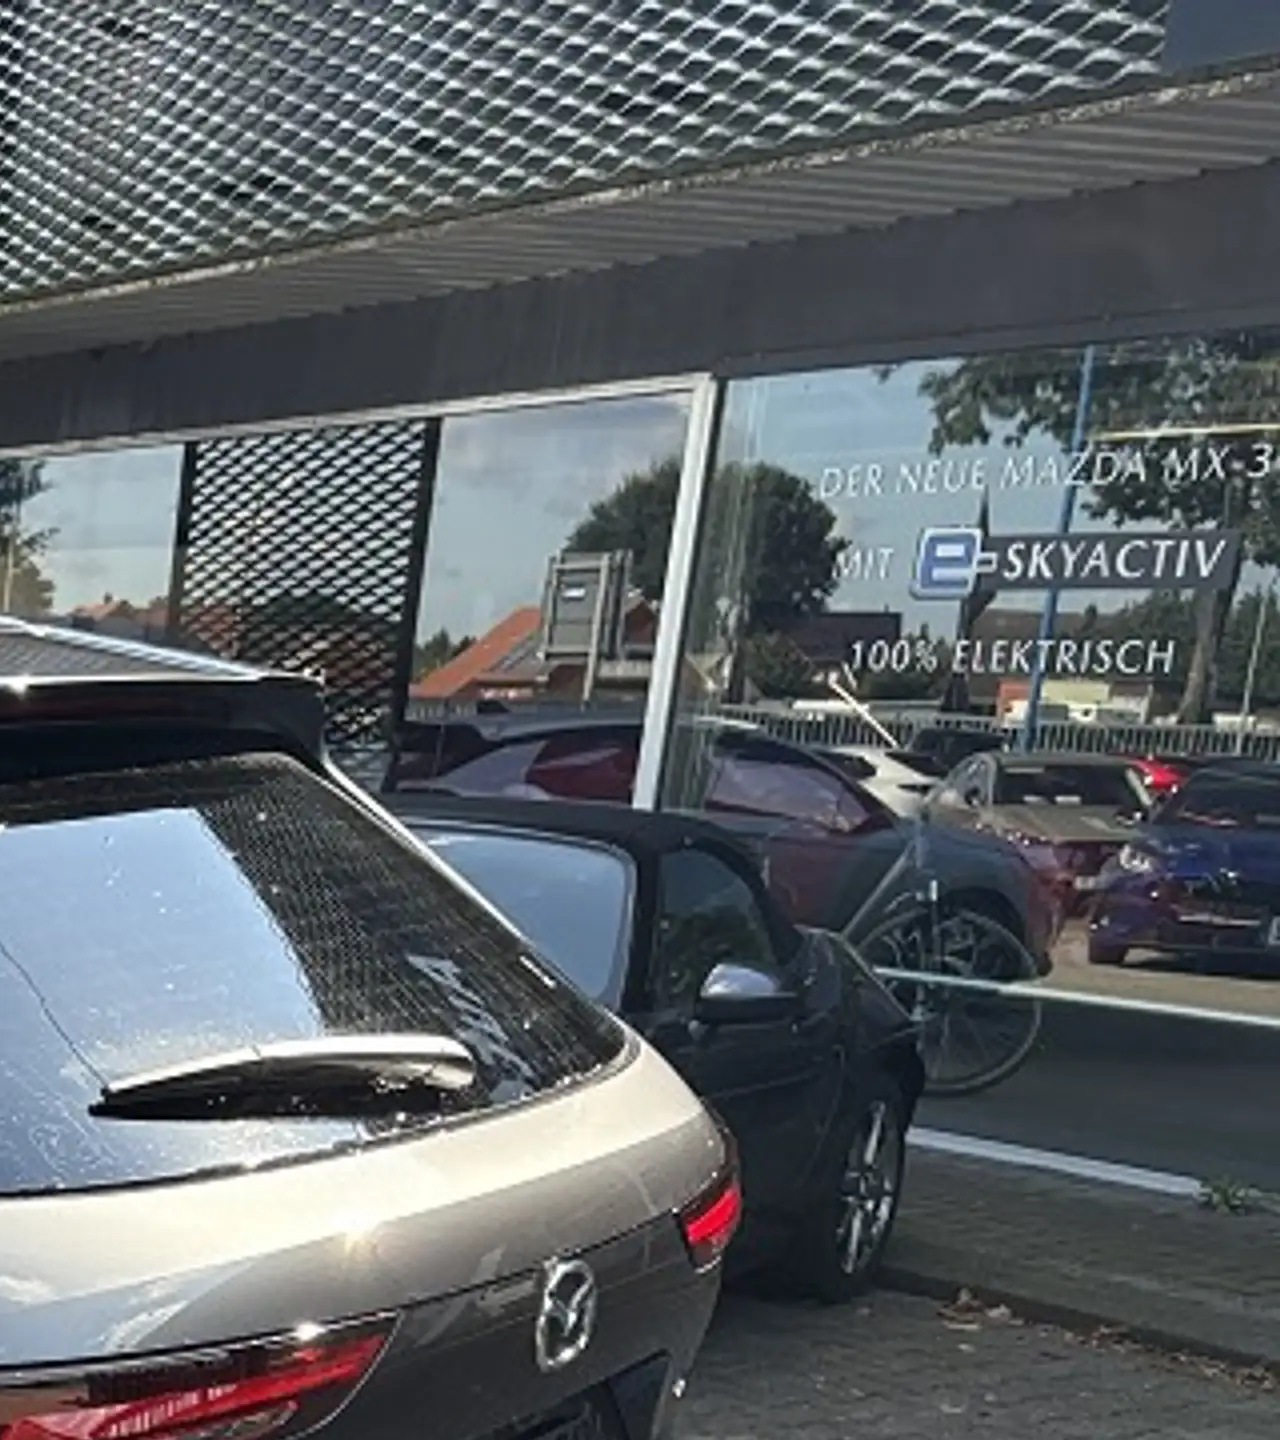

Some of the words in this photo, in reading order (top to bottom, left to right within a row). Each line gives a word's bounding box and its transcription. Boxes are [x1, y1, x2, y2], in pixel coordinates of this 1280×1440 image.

[818, 462, 882, 499] DER
[895, 458, 986, 494] NEUE
[999, 449, 1146, 490] MAZDA
[832, 546, 894, 582] MIT
[848, 638, 938, 674] 100%
[951, 638, 1176, 676] ELEKTRISCH
